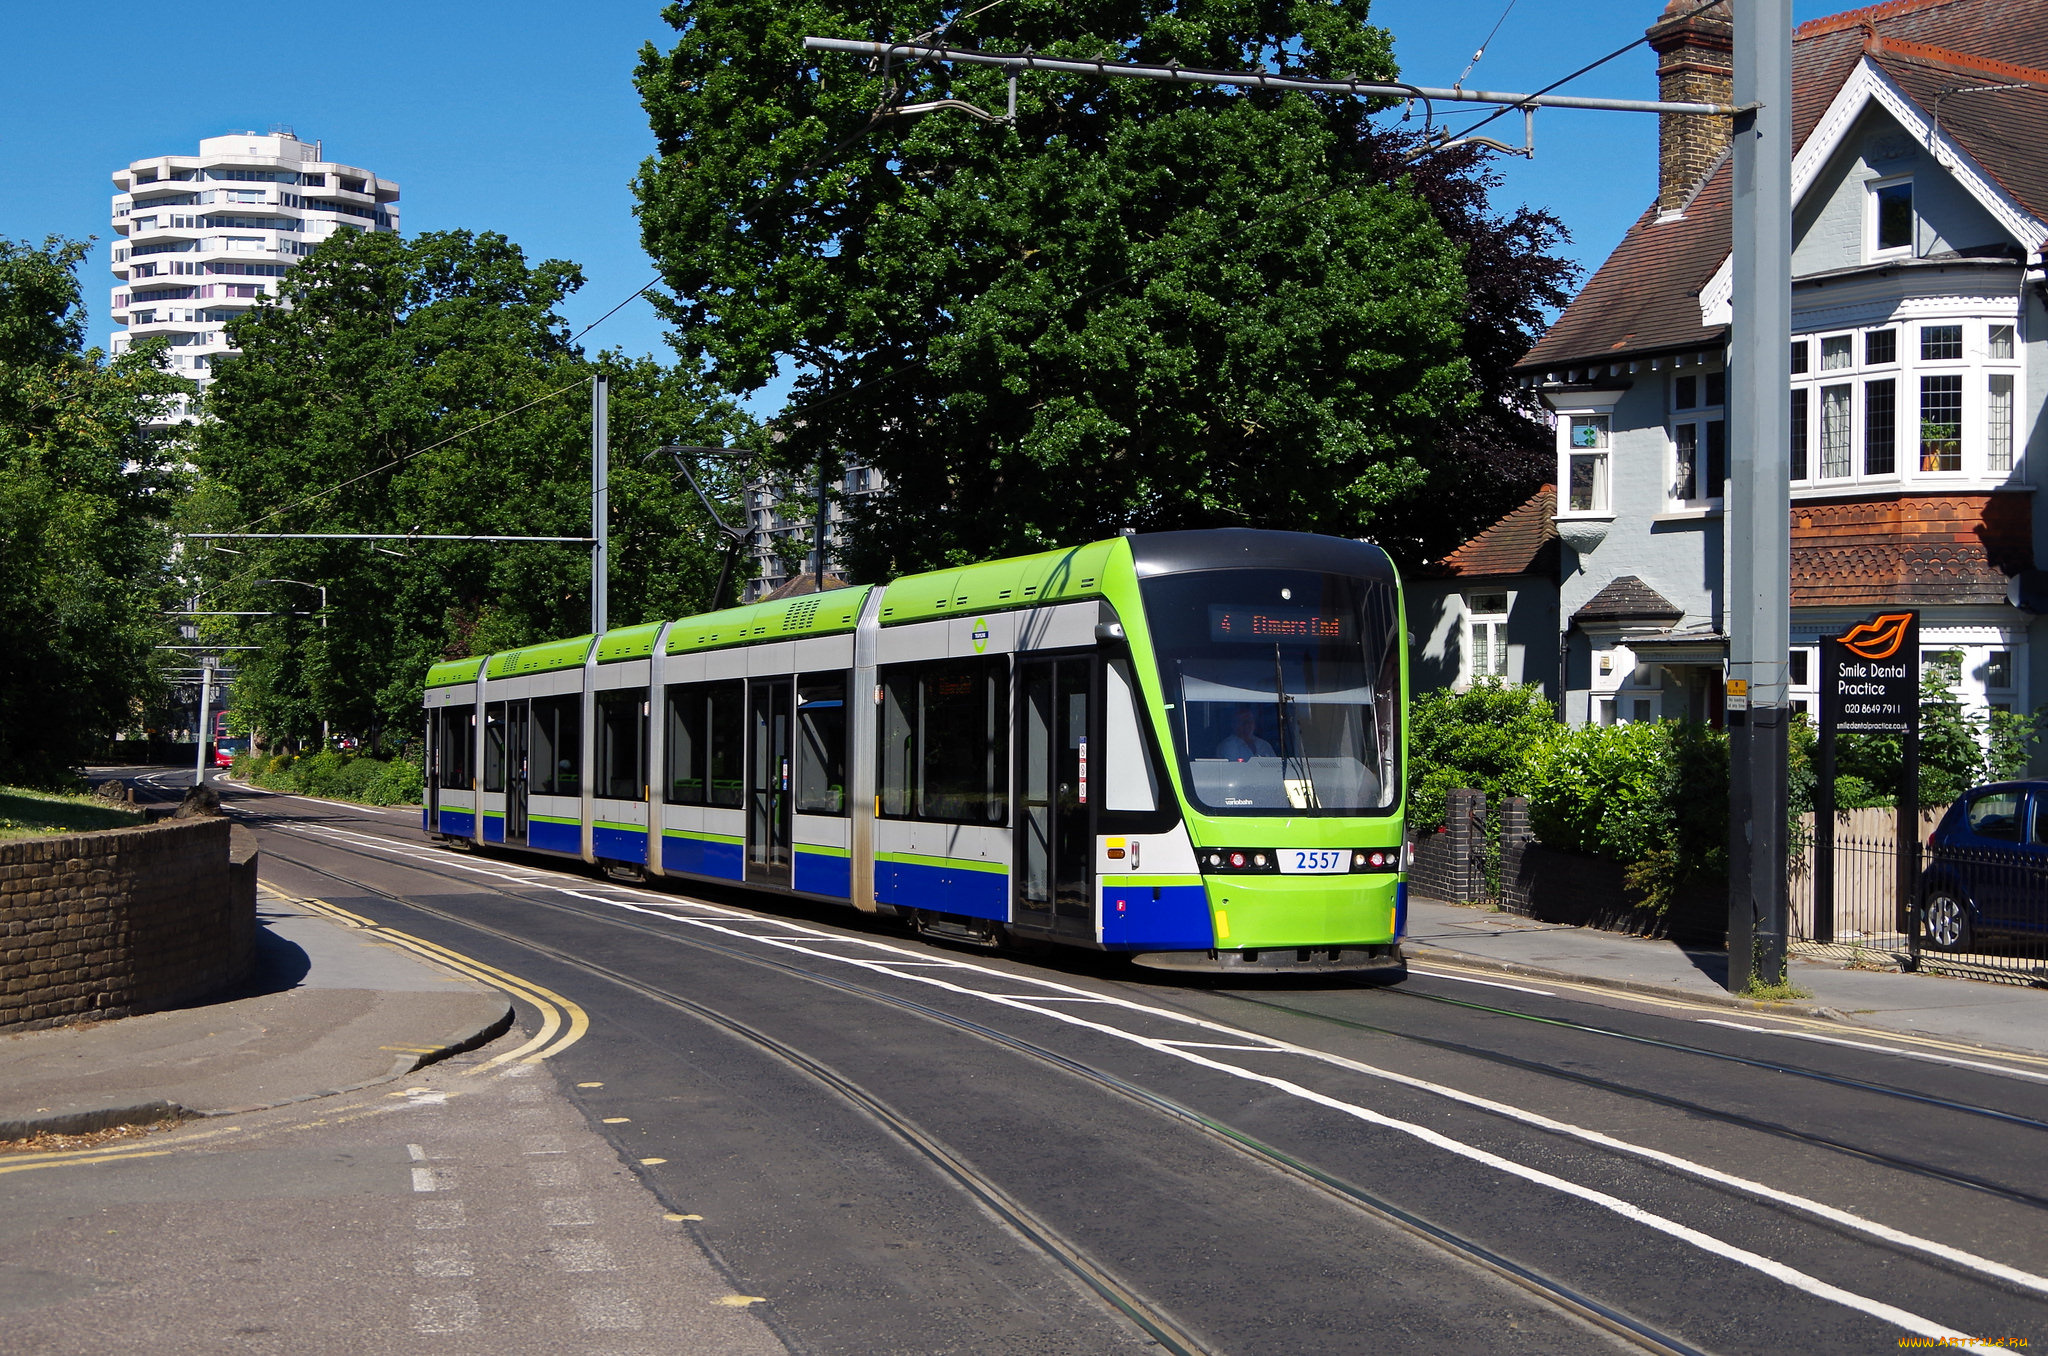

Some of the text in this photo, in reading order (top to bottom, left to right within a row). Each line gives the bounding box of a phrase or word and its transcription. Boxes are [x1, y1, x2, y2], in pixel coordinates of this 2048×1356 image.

[1221, 615, 1339, 636] 4 Elmers End
[1838, 662, 1906, 678] Smile Dental
[1838, 680, 1886, 695] Practice
[1844, 703, 1901, 714] 020 8649 7911
[1295, 852, 1340, 869] 2557
